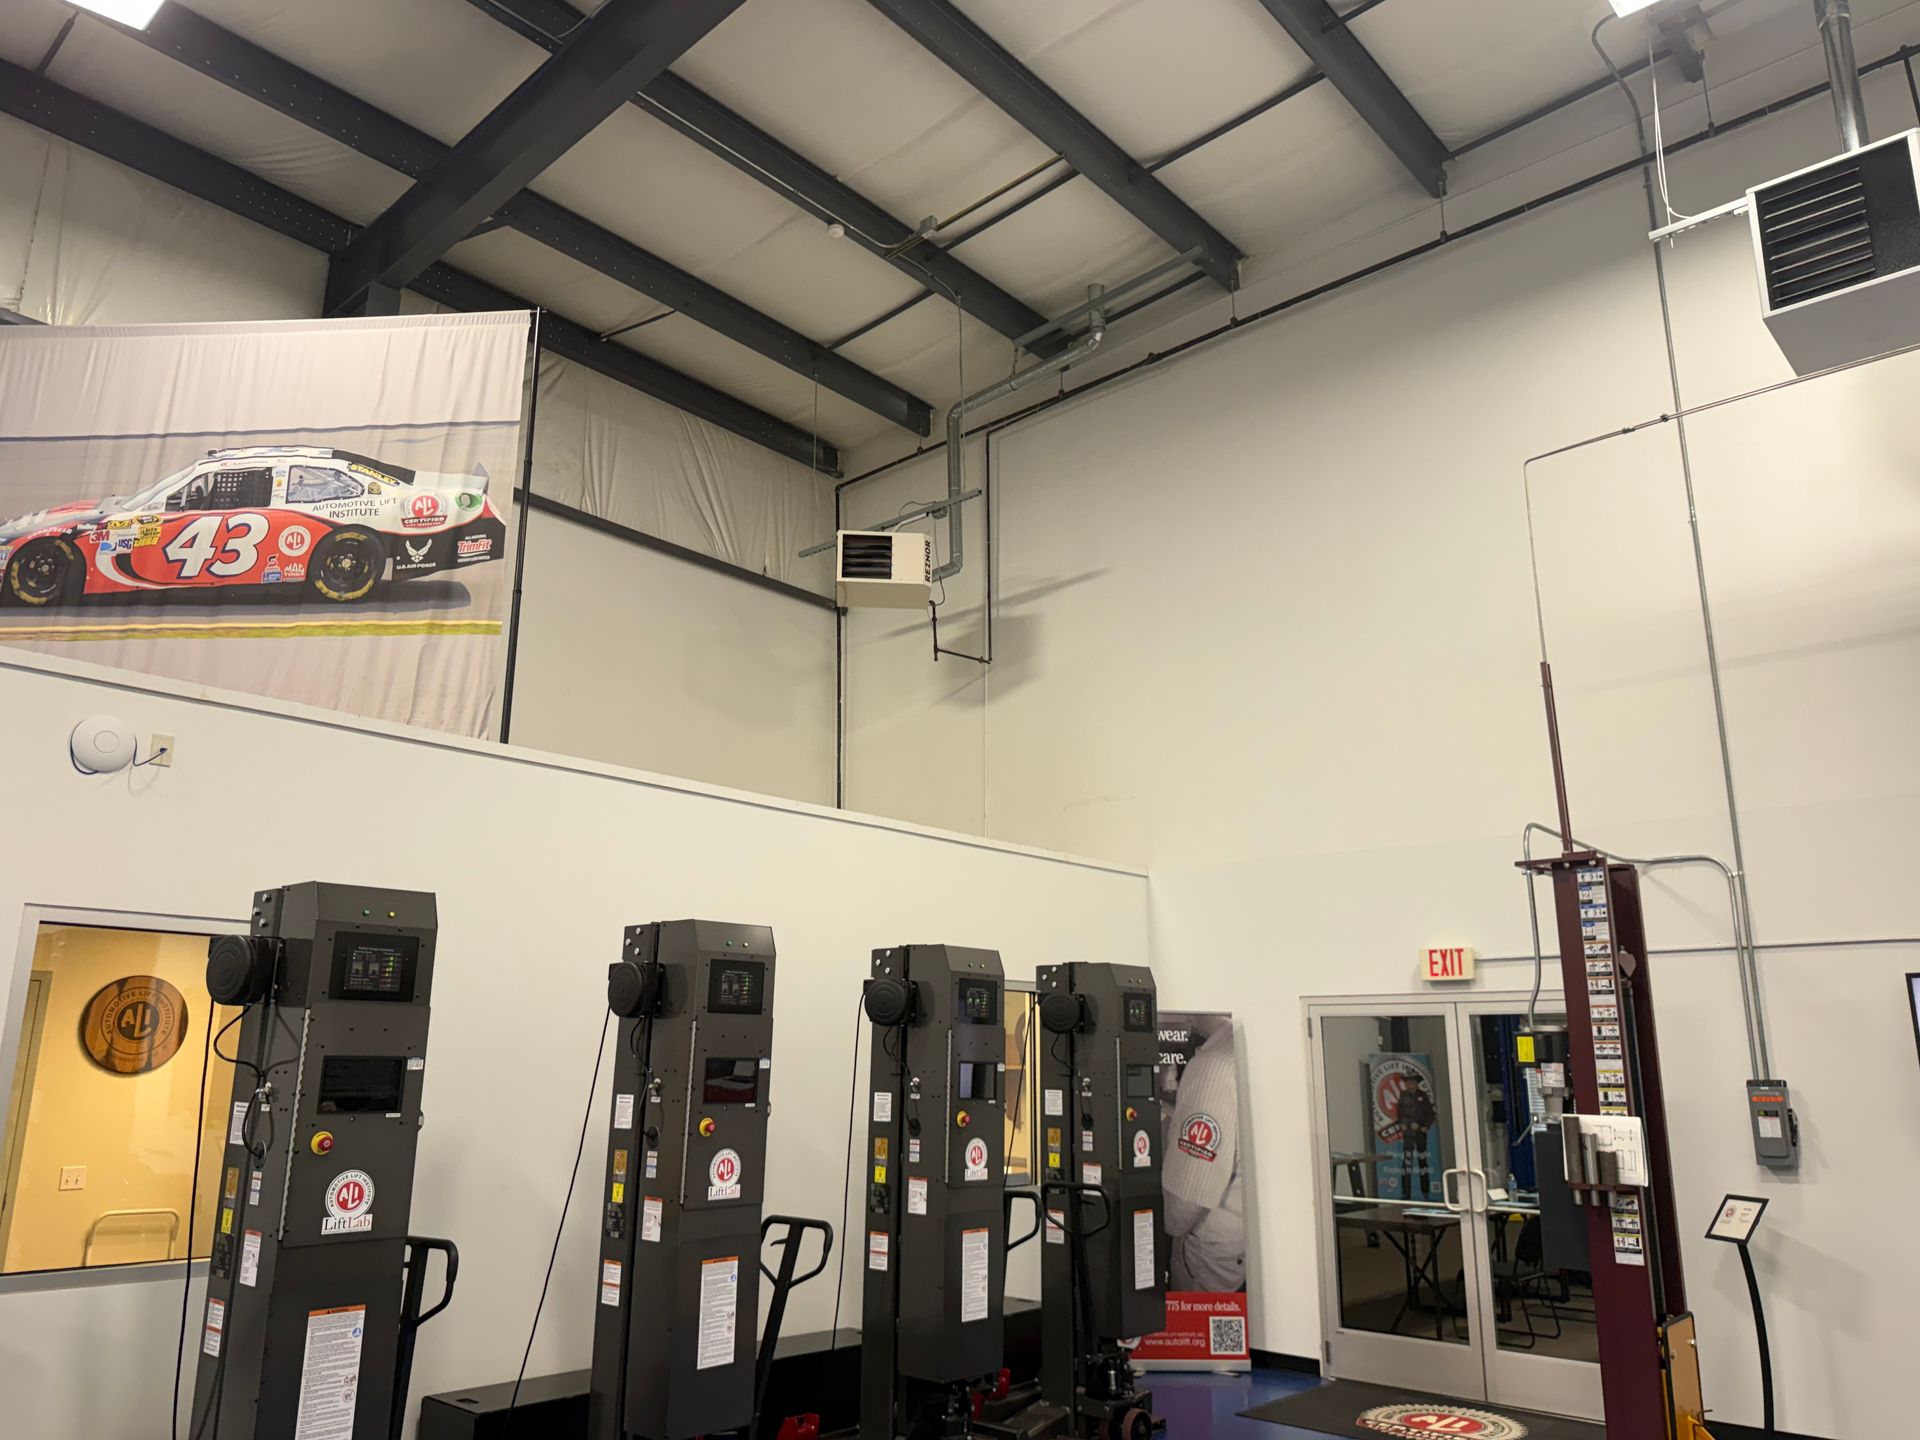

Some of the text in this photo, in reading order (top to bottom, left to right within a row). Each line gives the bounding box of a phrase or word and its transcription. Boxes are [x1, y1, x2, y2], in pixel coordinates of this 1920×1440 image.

[351, 463, 397, 485] STANLEY
[312, 497, 398, 512] AUTOMOTIVE LIFT
[329, 508, 380, 518] INSTITUTE
[414, 496, 435, 516] ALI
[403, 516, 445, 524] CERTIFIED
[90, 530, 110, 542] 3M
[286, 532, 302, 549] ALI
[164, 513, 270, 578] 43
[457, 538, 492, 554] TrimFit
[284, 562, 305, 573] MAC
[1428, 949, 1464, 977] EXIT
[104, 991, 137, 1035] AUTOMOTIVE
[120, 1003, 152, 1038] ALI
[1157, 1029, 1189, 1042] wear.
[1190, 1123, 1209, 1145] ALI
[718, 1159, 732, 1180] ALI
[329, 1175, 349, 1208] AUTOMOTIVE
[362, 1177, 372, 1205] INSTITUTE
[338, 1182, 360, 1209] ALI
[1180, 1301, 1192, 1311] for
[1193, 1303, 1214, 1311] more
[1214, 1301, 1241, 1312] details.
[1144, 1338, 1206, 1347] www.autolift.org
[1410, 1415, 1470, 1432] ALI
